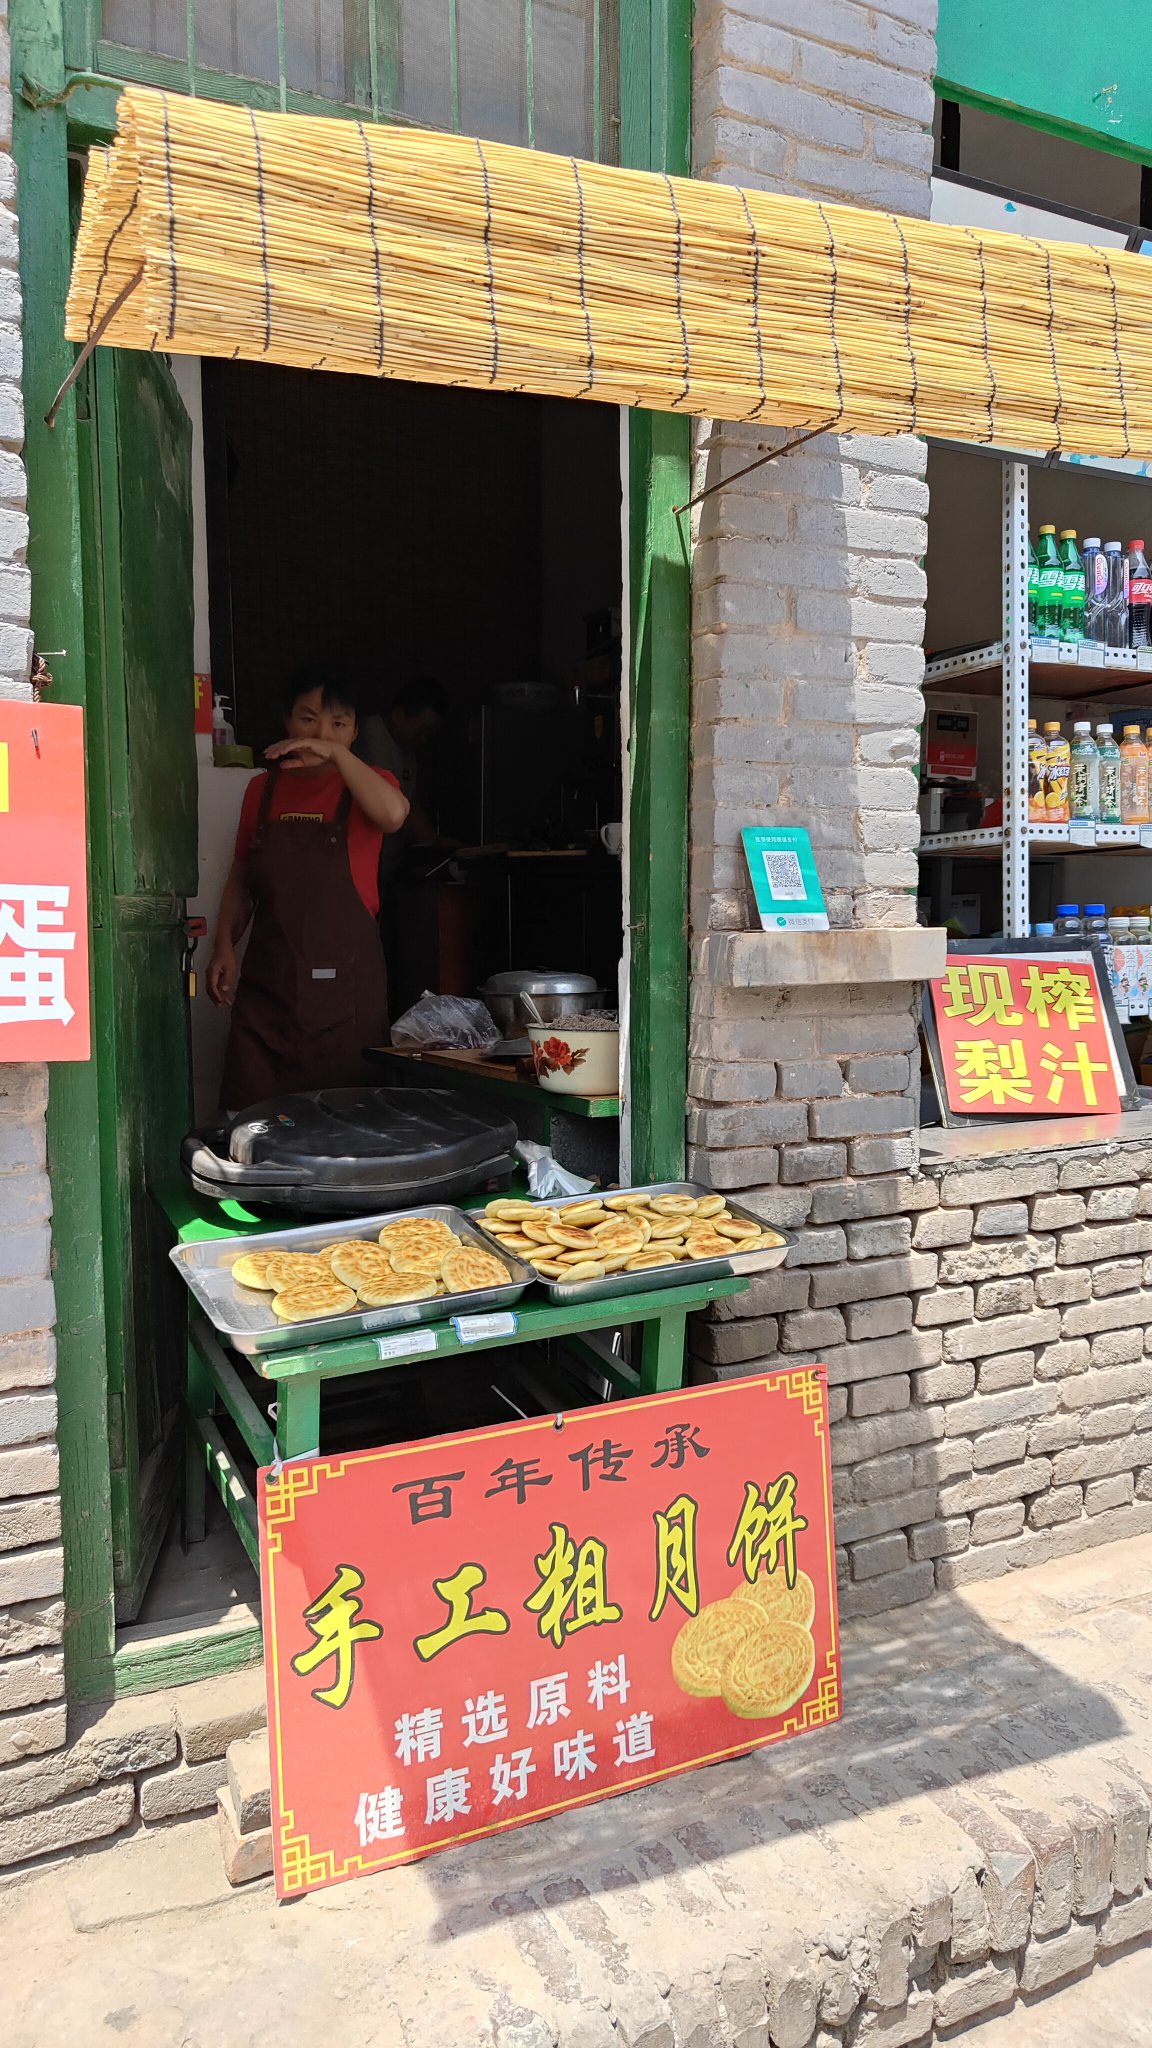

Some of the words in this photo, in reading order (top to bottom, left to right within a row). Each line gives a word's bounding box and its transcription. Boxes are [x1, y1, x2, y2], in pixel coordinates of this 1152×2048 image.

[941, 964, 1097, 1031] 现榨
[954, 1038, 1109, 1106] 梨汁
[392, 1422, 711, 1525] 百年传承
[291, 1473, 808, 1710] 手工粗月饼
[394, 1653, 632, 1768] 精选原料
[353, 1713, 657, 1847] 健康好味道
